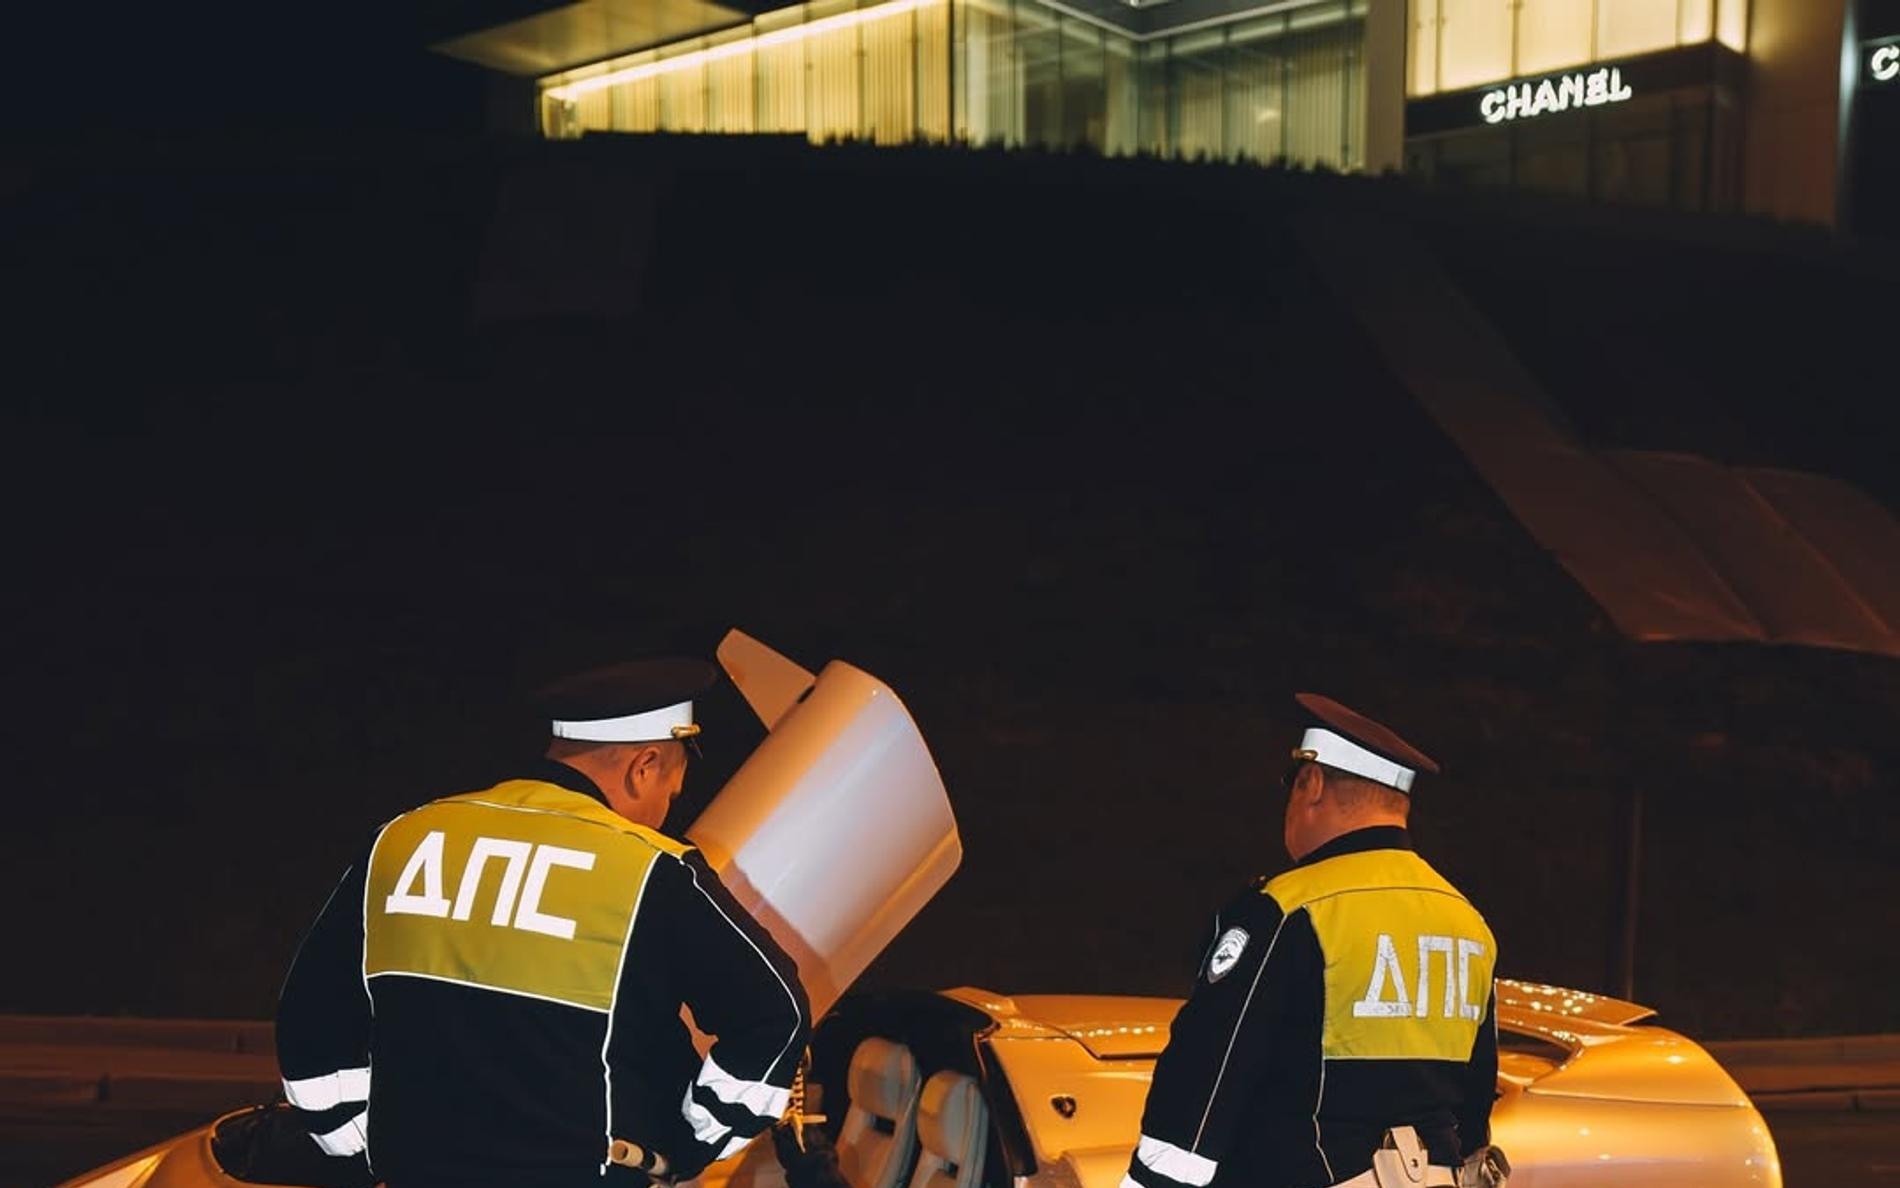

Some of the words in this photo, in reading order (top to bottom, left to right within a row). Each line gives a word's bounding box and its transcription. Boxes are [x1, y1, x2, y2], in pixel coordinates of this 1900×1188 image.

[1480, 67, 1632, 123] CHANEL
[385, 831, 596, 941] ДПС
[1353, 933, 1484, 1020] ДПС
